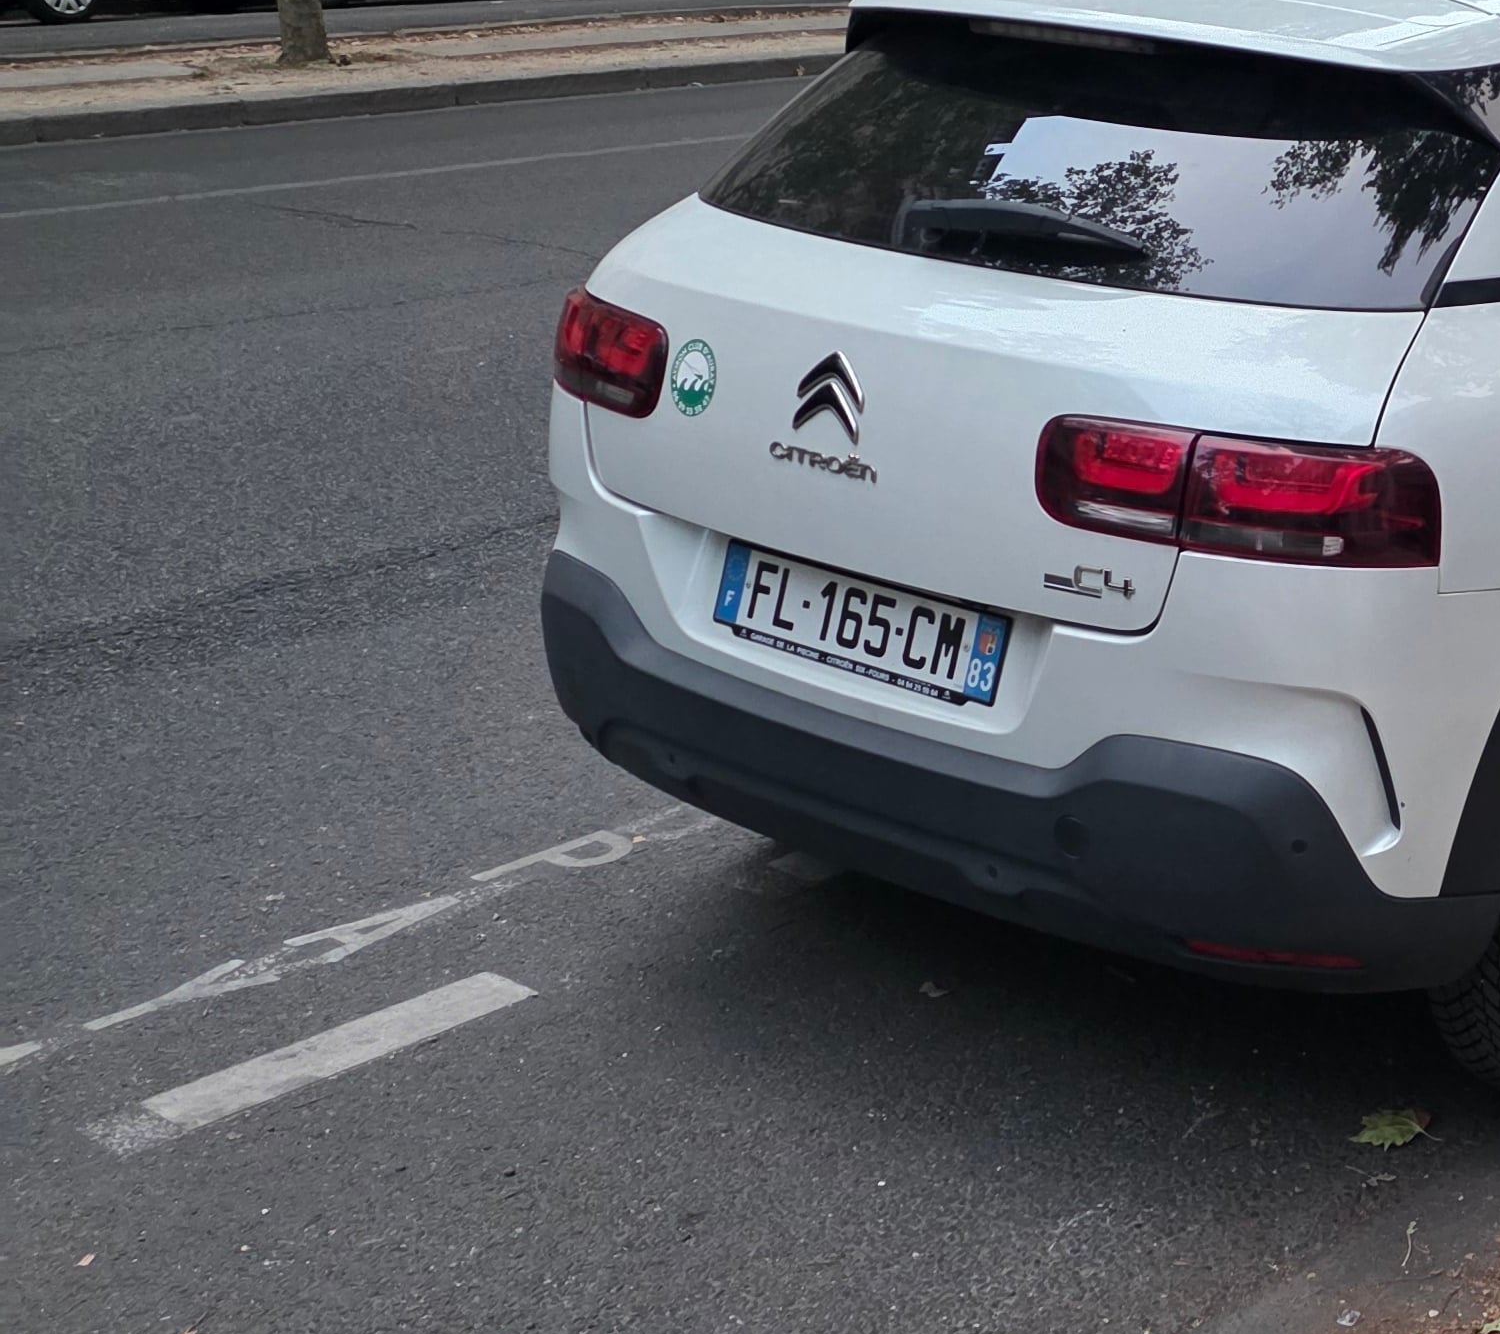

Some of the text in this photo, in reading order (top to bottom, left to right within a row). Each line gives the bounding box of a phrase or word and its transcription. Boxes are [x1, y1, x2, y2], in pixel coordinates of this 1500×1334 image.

[723, 590, 735, 607] F
[1072, 564, 1137, 600] C4
[747, 560, 967, 681] FL-165-CM
[750, 632, 775, 646] GARAGE
[776, 640, 785, 649] DE
[786, 643, 795, 652] LA
[967, 658, 996, 692] 83
